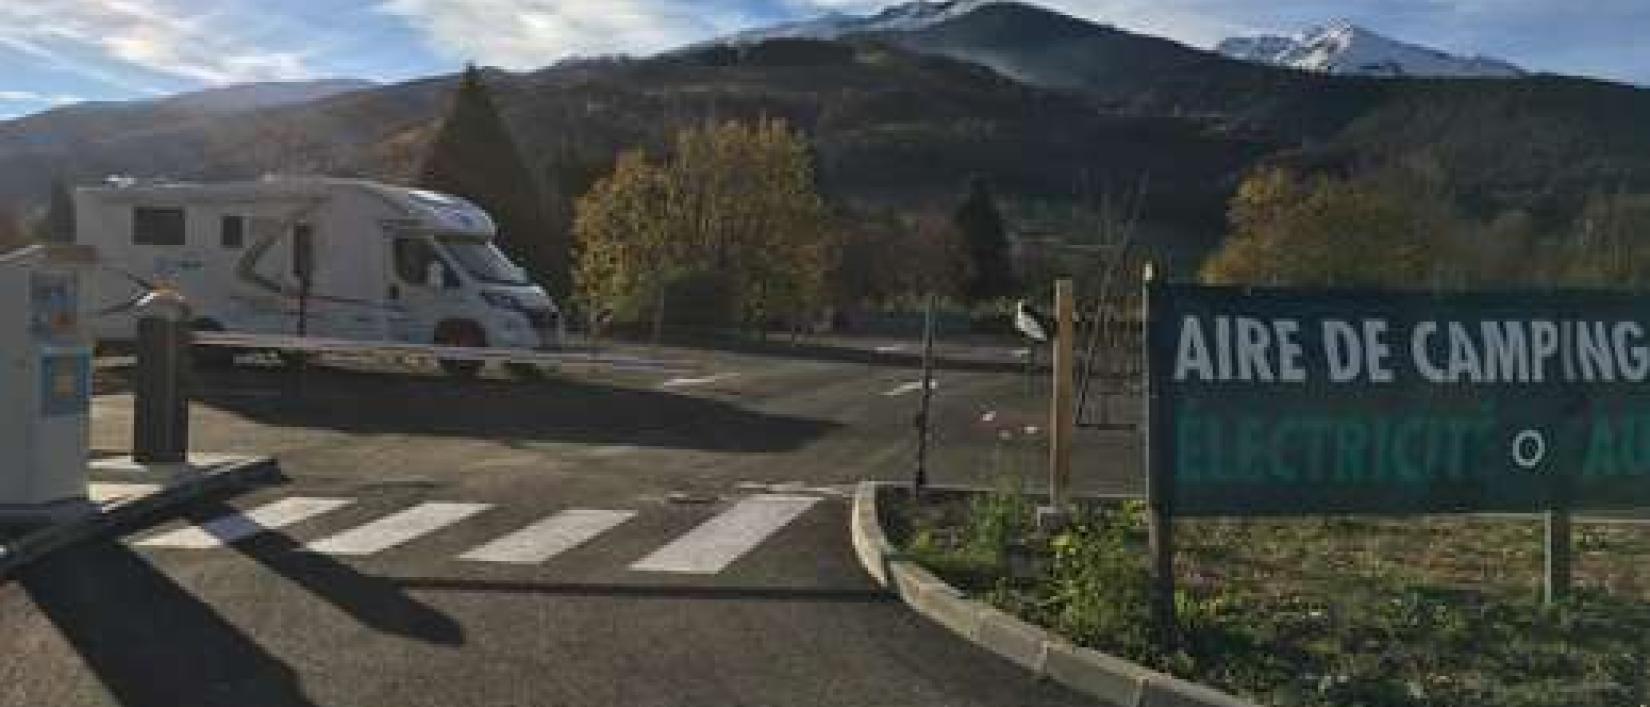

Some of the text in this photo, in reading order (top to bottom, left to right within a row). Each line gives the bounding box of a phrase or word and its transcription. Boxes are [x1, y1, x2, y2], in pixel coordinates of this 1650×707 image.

[1173, 315, 1649, 383] AIRE DE CAMPING
[1174, 401, 1496, 483] ÉLECTRICIT
